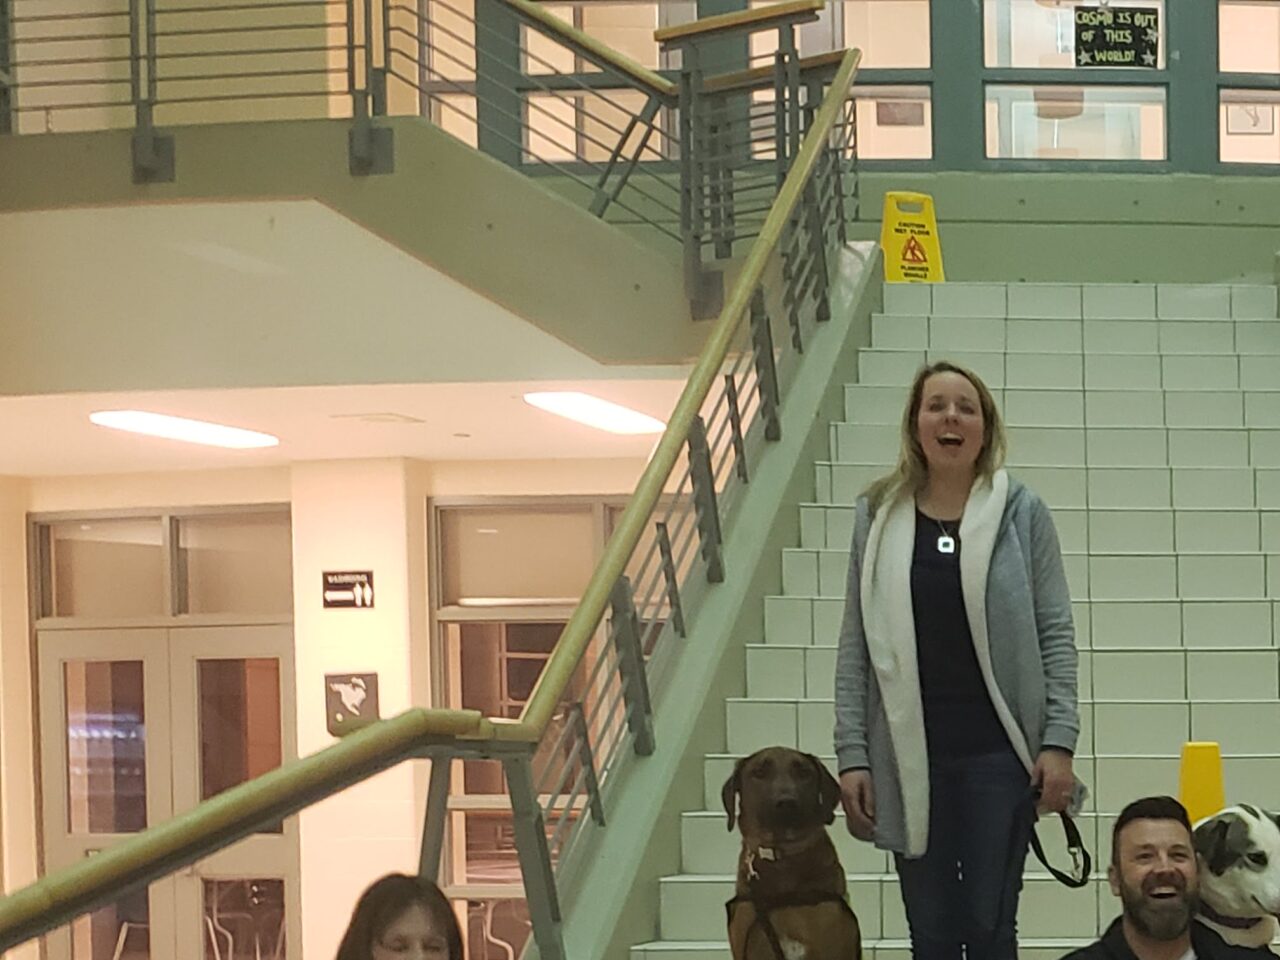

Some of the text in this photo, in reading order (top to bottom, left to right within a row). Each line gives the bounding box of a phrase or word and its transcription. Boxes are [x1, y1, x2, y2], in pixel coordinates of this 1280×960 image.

[1116, 11, 1132, 24] IS
[1134, 12, 1156, 28] OUT
[1103, 29, 1133, 44] THIS
[1093, 49, 1136, 62] WORLD!
[898, 221, 926, 229] CAUTION
